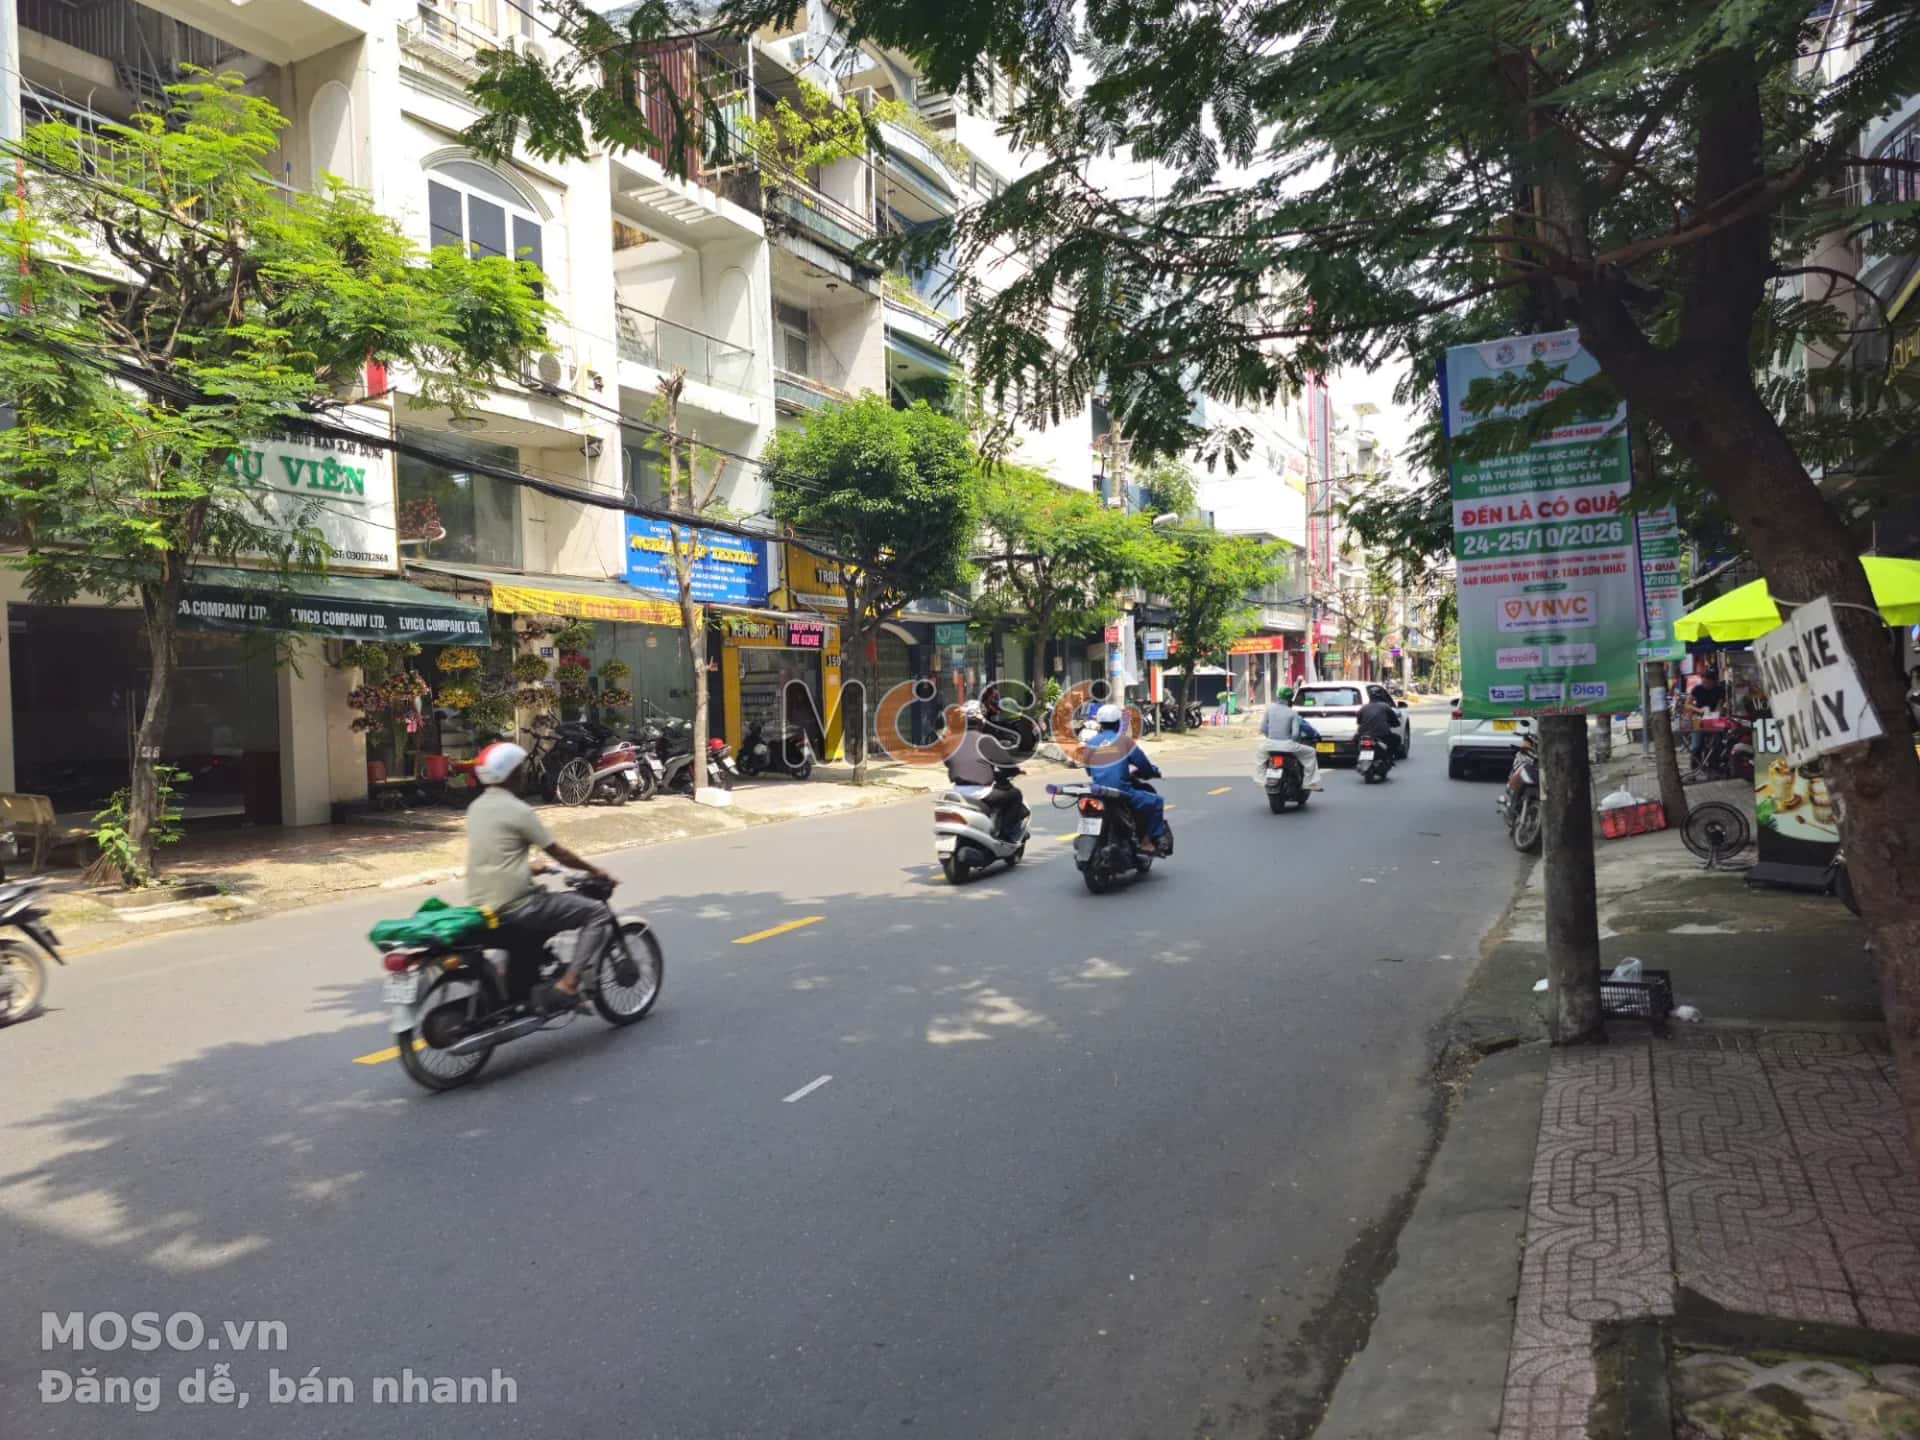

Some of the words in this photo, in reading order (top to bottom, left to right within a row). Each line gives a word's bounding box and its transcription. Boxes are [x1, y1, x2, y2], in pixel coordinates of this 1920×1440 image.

[279, 456, 366, 496] VIÊN
[1461, 505, 1503, 527] ĐẾN
[1507, 500, 1533, 522] LÀ
[1537, 496, 1570, 518] CÓ
[1574, 490, 1620, 515] QUÀ
[1463, 522, 1623, 556] 24-25/10/2026
[192, 601, 247, 620] COMPANY
[322, 610, 367, 627] COMPANY
[369, 614, 388, 629] LTD.
[1526, 597, 1588, 616] VNVC
[425, 618, 465, 633] COMPANY
[466, 621, 484, 634] LTD.
[1802, 624, 1839, 673] XE
